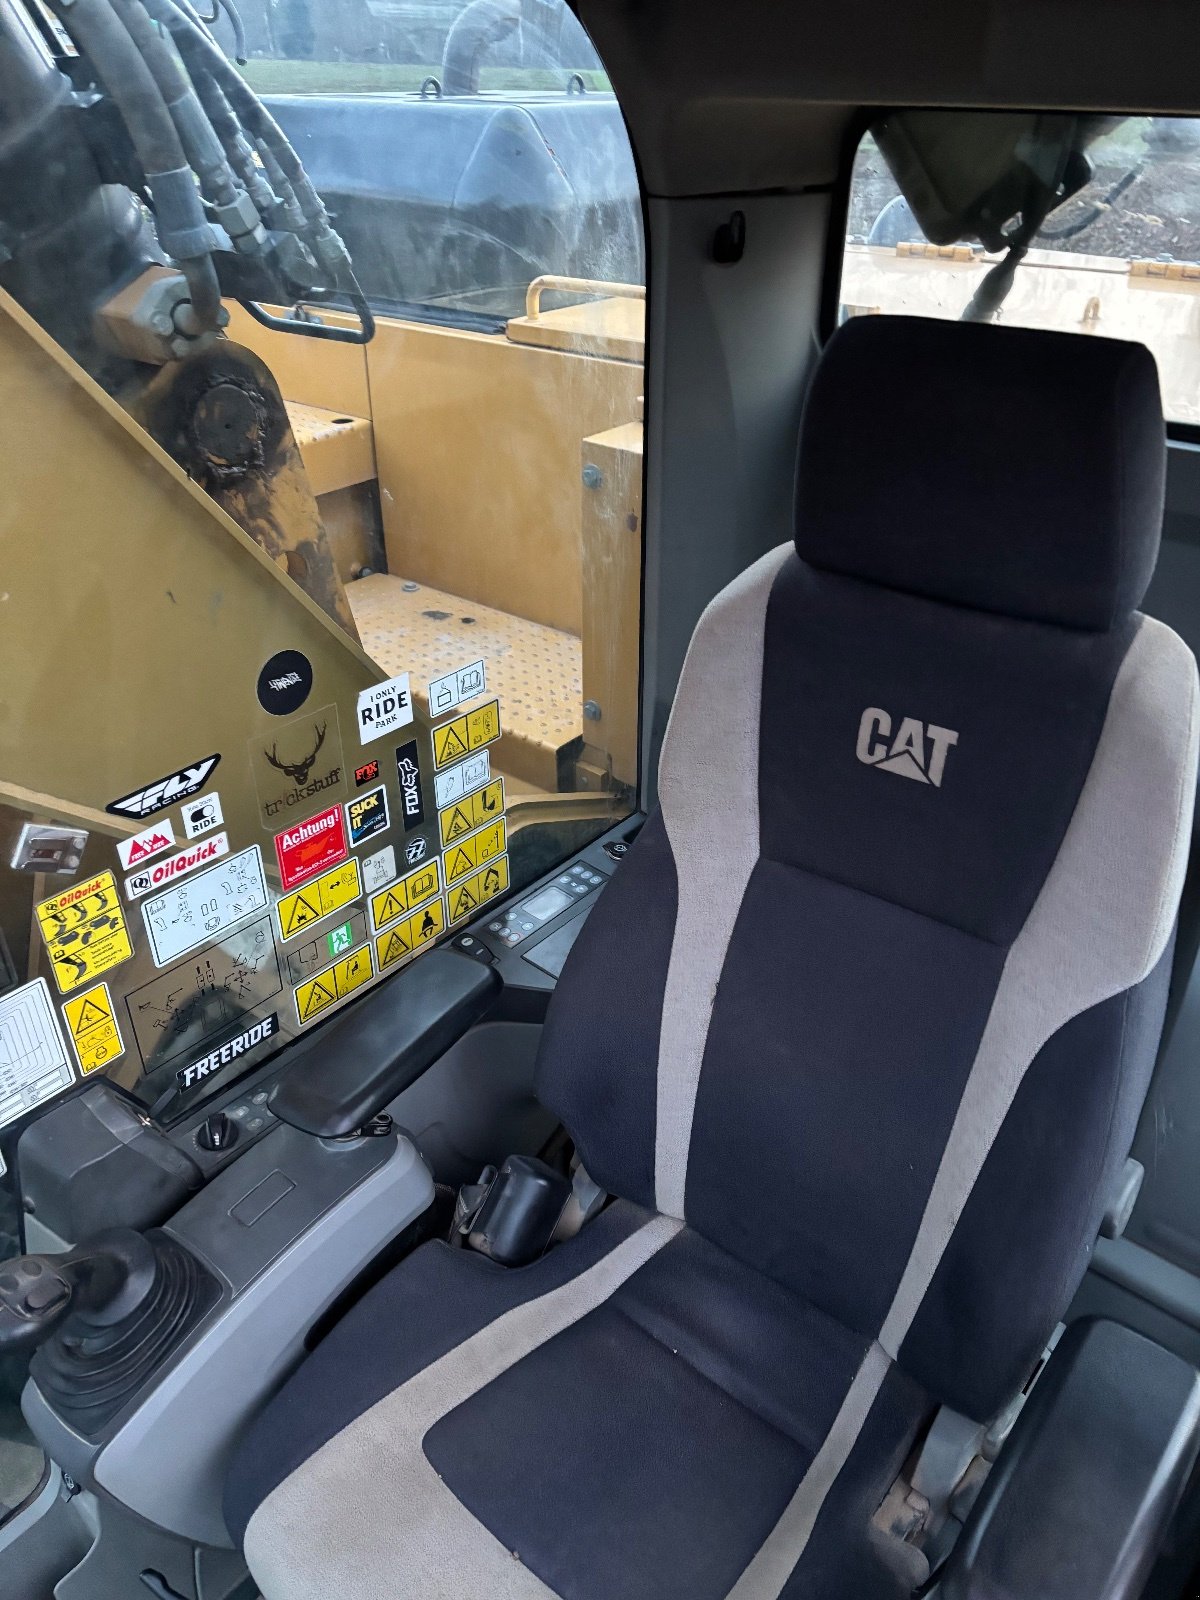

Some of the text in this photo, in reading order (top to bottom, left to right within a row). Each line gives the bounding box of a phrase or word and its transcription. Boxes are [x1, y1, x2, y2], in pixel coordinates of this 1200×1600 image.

[376, 685, 397, 700] ONLY
[361, 691, 408, 726] RIDE
[375, 713, 398, 729] PARK
[856, 707, 959, 788] CAT
[112, 758, 216, 812] FLY
[355, 760, 378, 781] FOX
[140, 785, 198, 816] RACING
[350, 794, 380, 818] SUCK
[403, 785, 420, 816] FOX
[192, 815, 217, 833] RIDE
[282, 808, 340, 850] Achtung!
[352, 815, 364, 830] IT
[152, 841, 218, 883] OilQuick
[59, 880, 102, 907] OilQuick
[183, 1017, 273, 1087] FREERIDE
